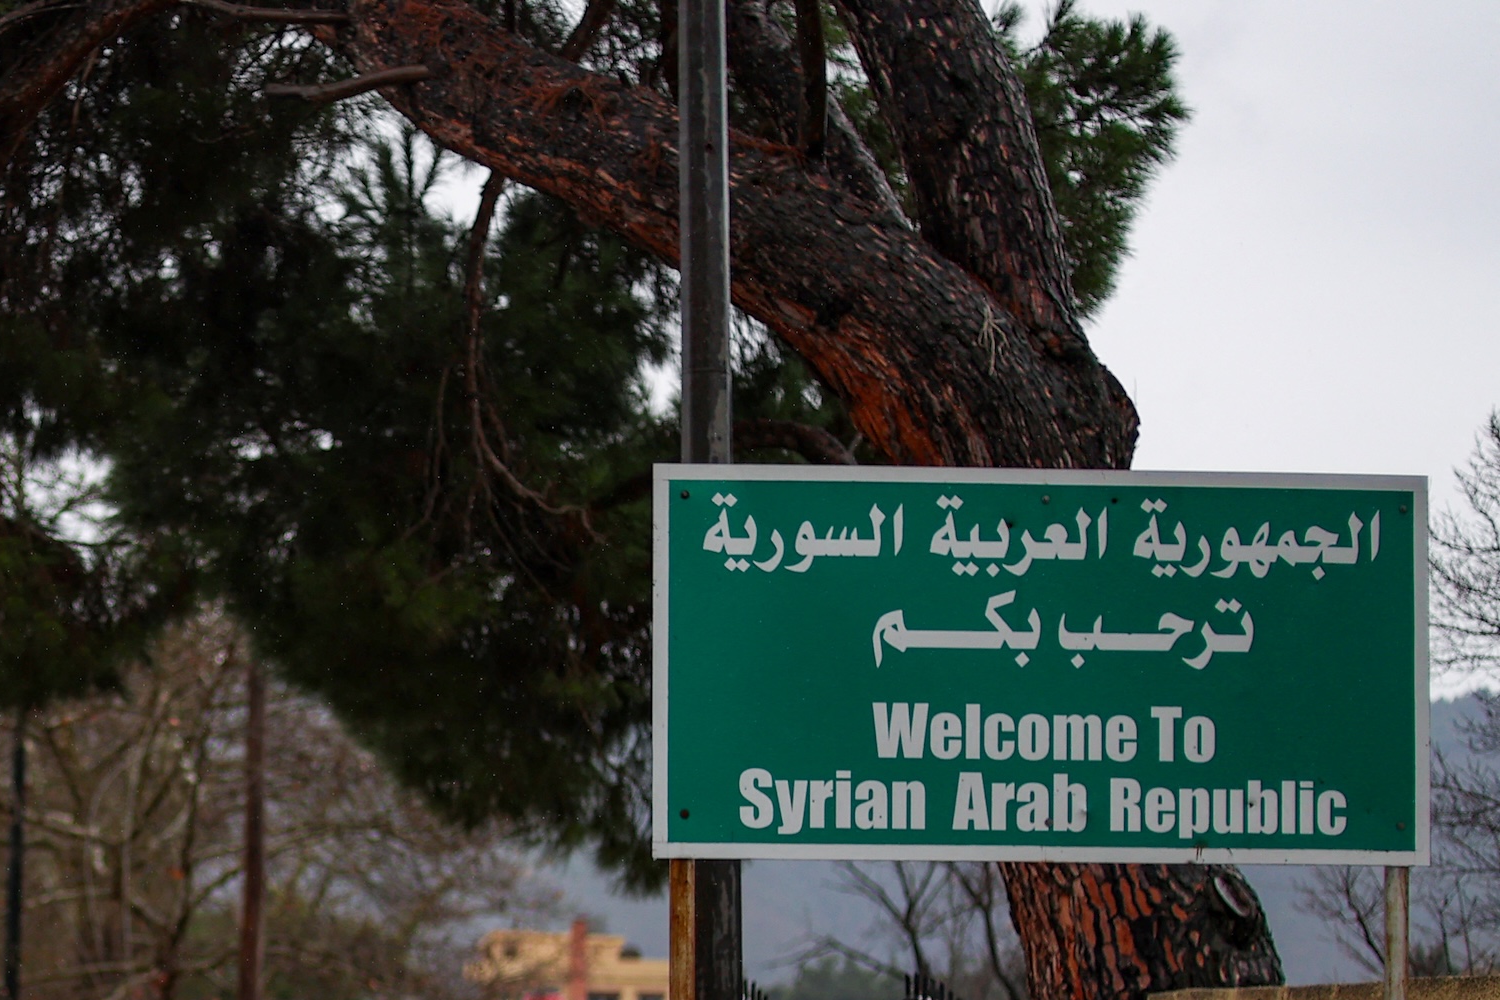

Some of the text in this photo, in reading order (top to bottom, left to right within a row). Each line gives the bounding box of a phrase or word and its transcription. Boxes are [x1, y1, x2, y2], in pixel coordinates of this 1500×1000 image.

[702, 492, 1380, 581] الجمهورية العربية السورية
[872, 702, 1216, 763] Welcome To
[739, 767, 1348, 840] Syrian Arab Republic
